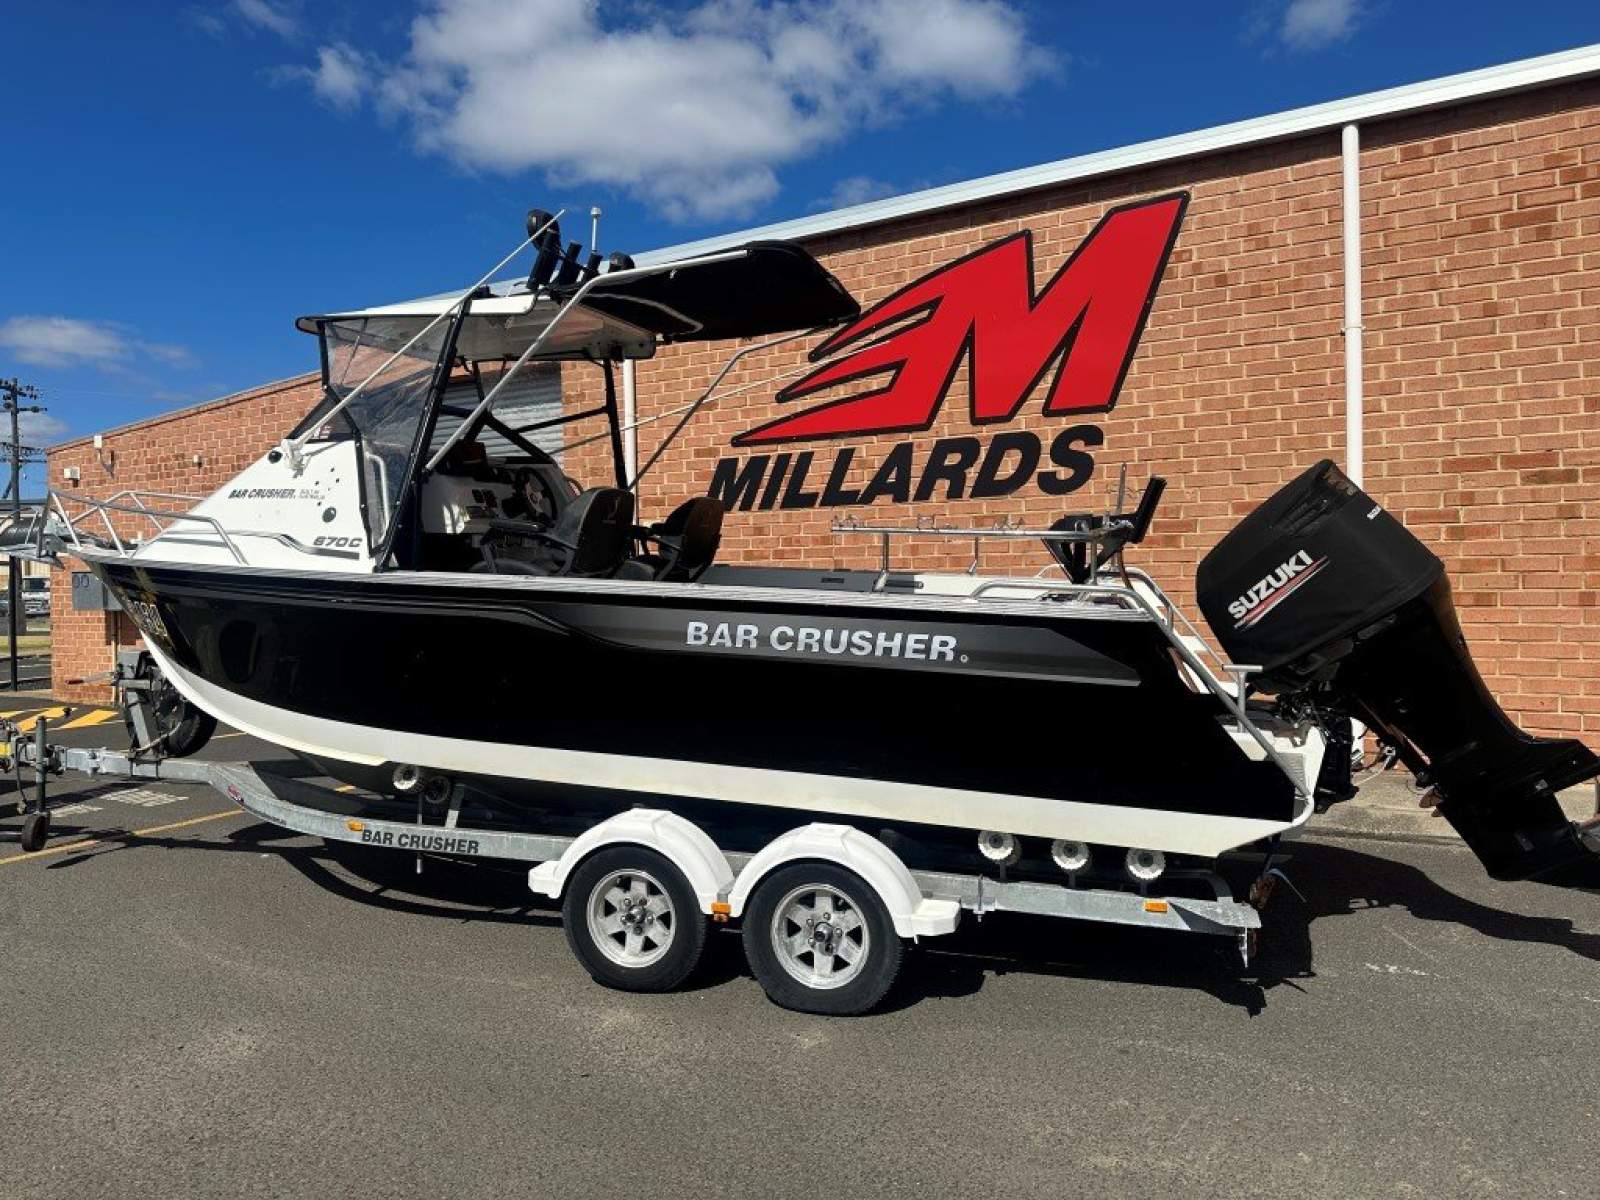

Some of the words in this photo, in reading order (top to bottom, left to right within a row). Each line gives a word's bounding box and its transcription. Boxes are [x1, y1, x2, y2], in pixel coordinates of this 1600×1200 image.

[707, 425, 1104, 511] MILLARDS
[228, 488, 249, 499] BAR
[248, 488, 296, 500] CRUSHER
[313, 535, 363, 547] 670C
[1227, 549, 1313, 619] SUZUKI
[685, 621, 759, 649] BAR
[769, 625, 957, 662] CRUSHER
[361, 829, 394, 846] BAR
[397, 833, 480, 854] CRUSHER
